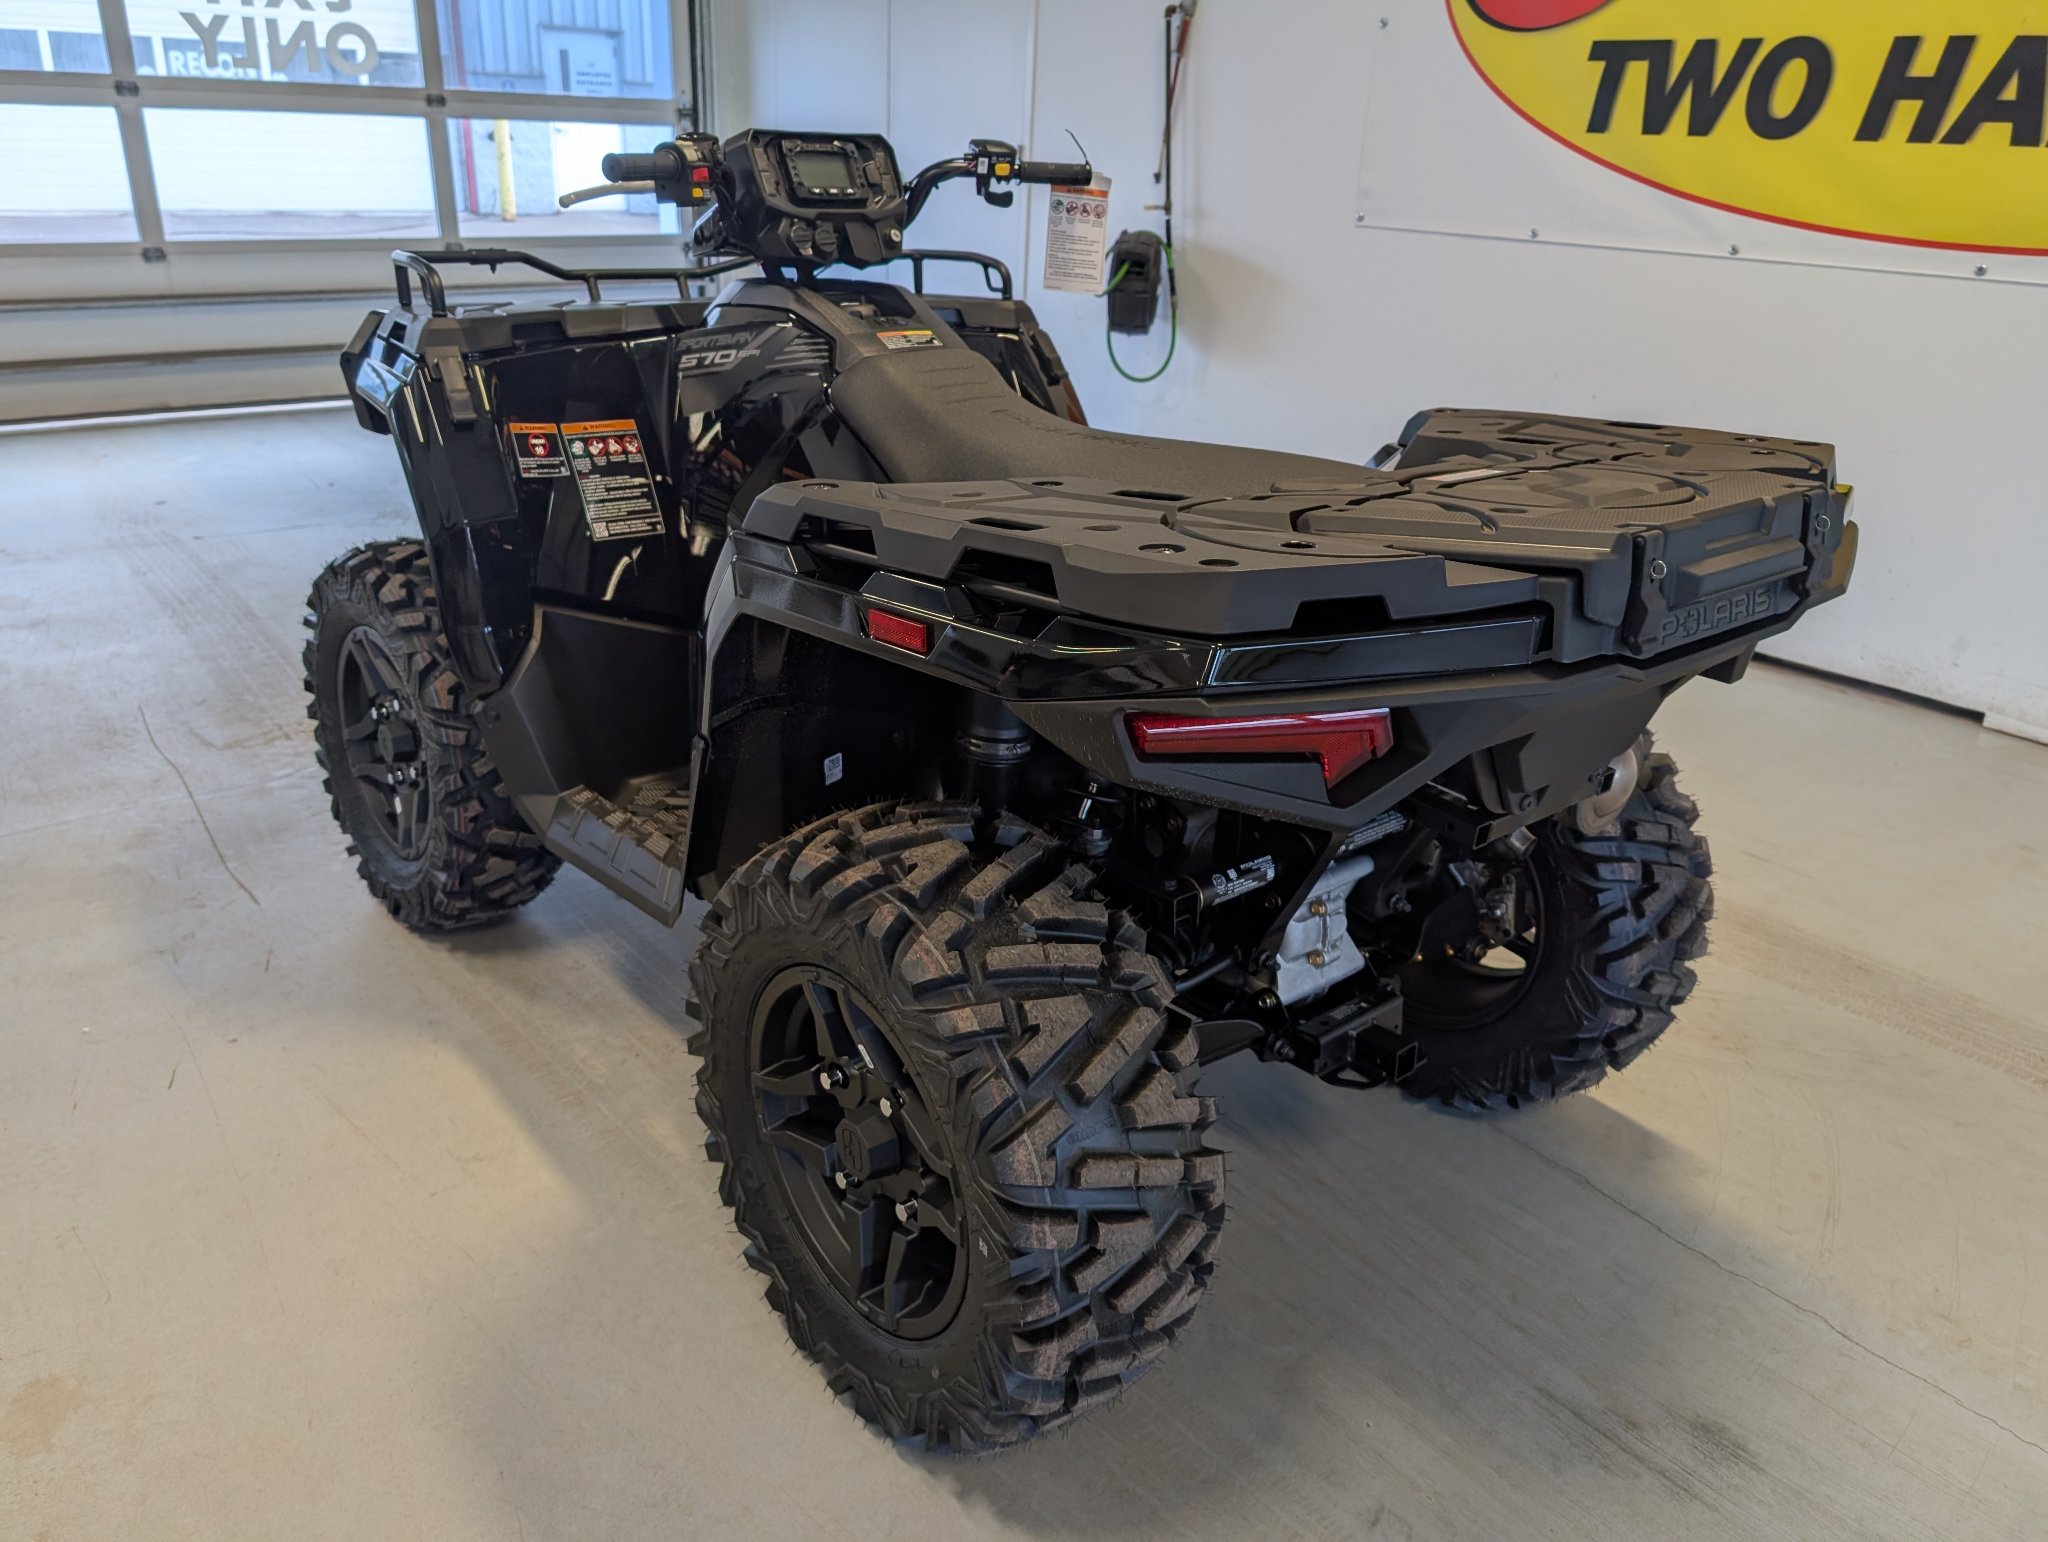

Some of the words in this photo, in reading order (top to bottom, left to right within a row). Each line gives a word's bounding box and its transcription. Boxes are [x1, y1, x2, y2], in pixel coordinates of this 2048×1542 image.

[1586, 35, 1834, 140] TWO
[1853, 34, 2048, 148] HA
[679, 349, 738, 368] 570
[1663, 590, 1770, 644] POLARIS
